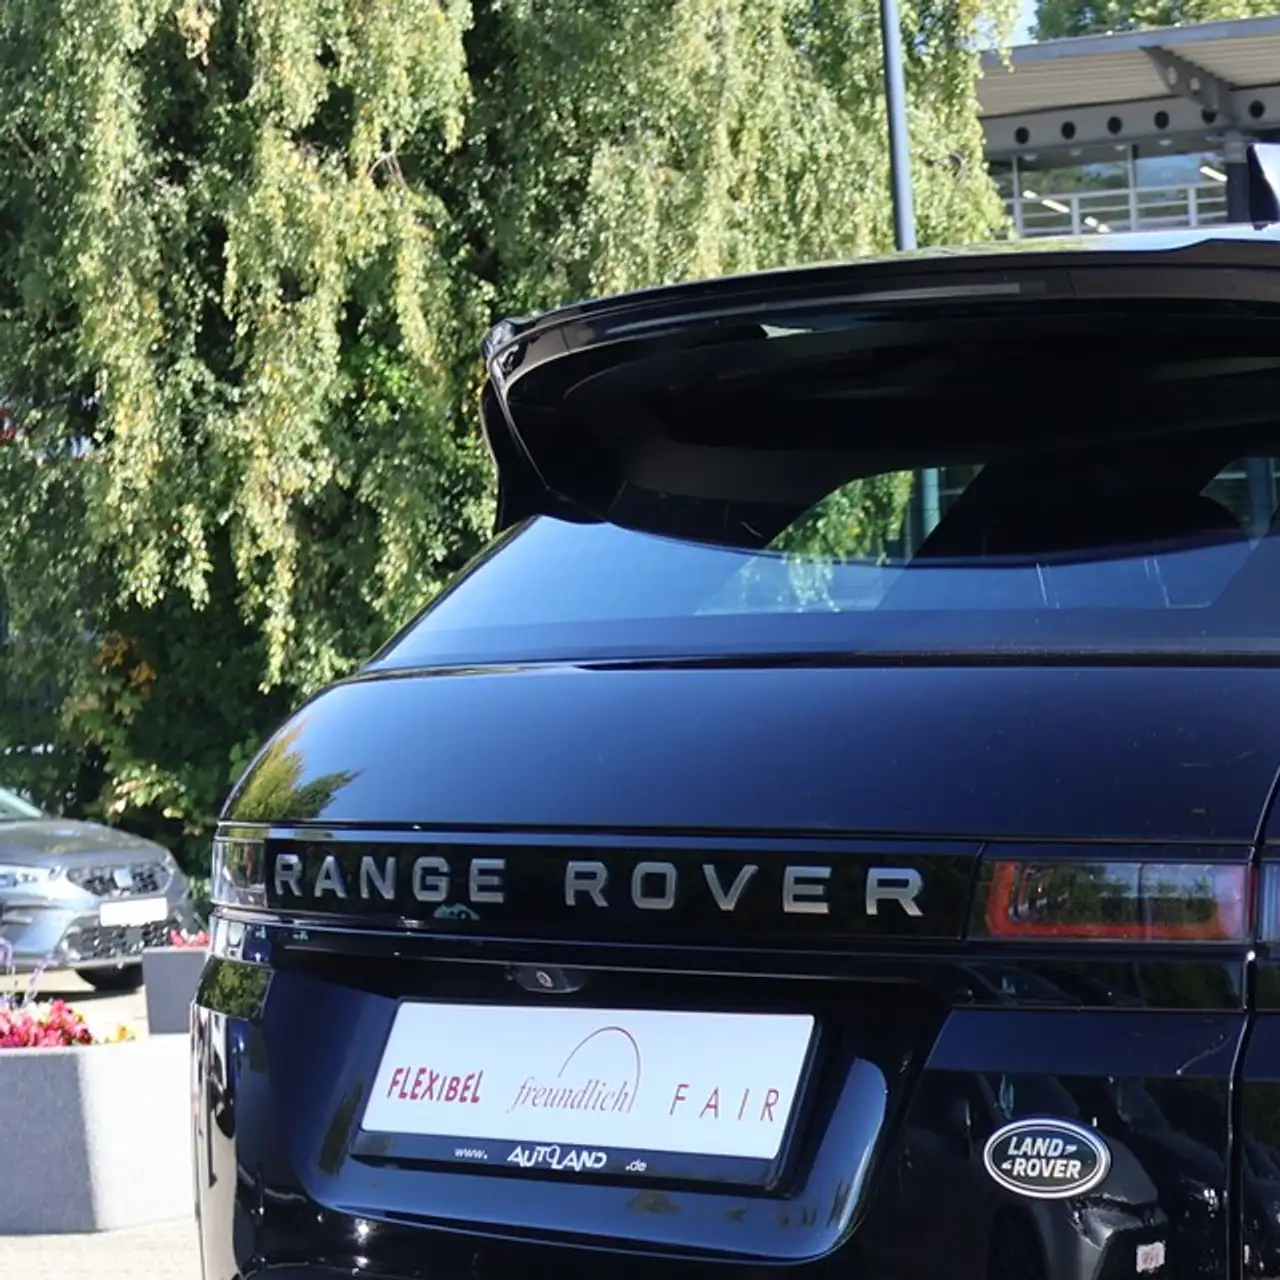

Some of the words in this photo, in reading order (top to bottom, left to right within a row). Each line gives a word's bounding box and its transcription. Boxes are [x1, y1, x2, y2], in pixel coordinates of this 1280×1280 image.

[274, 854, 505, 903] RANGE
[564, 860, 924, 917] ROVER
[387, 1066, 484, 1104] FLEXIBEL
[506, 1076, 629, 1113] freundlich
[670, 1084, 781, 1122] FAIR
[454, 1147, 488, 1161] www.
[507, 1144, 607, 1172] AUTOLAND
[625, 1159, 647, 1172] .de
[1007, 1136, 1064, 1158] LAND
[1012, 1157, 1082, 1179] ROVER
